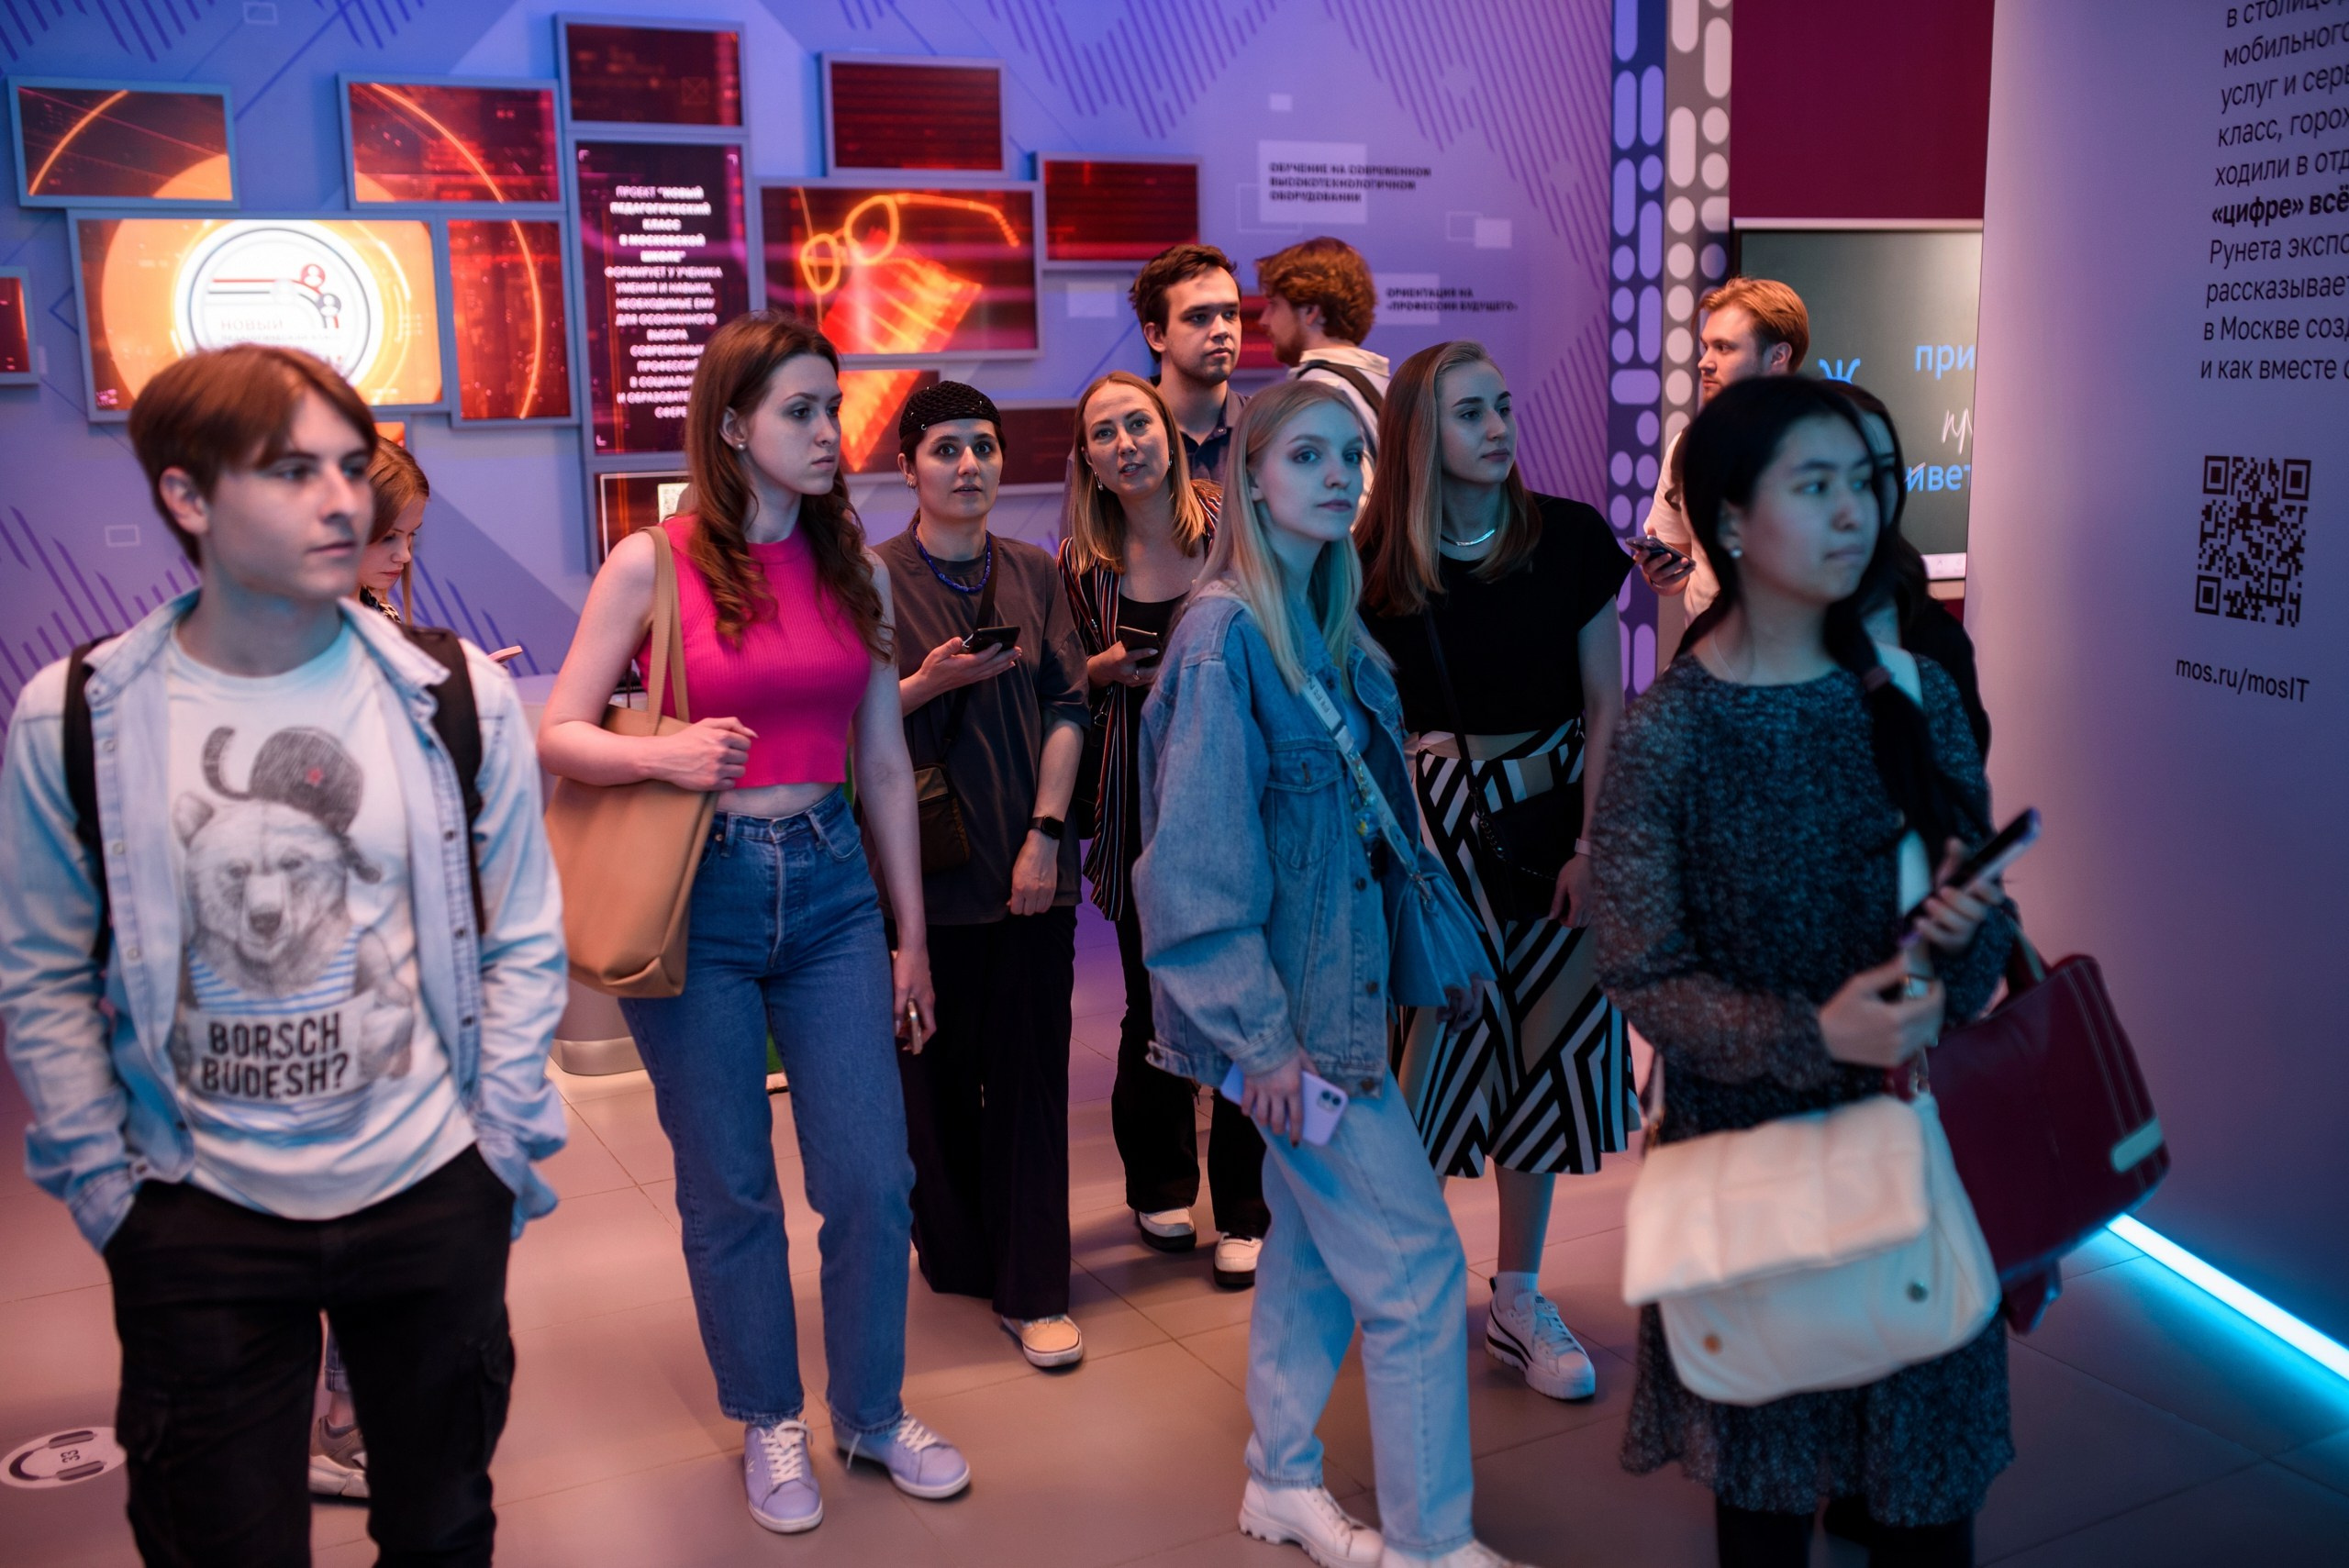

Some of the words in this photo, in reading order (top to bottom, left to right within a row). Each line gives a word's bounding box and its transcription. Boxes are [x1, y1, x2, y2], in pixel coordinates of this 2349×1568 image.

[2227, 8, 2237, 28] в
[2243, 0, 2331, 24] столи
[2224, 22, 2349, 68] мобильного
[2221, 79, 2278, 115] услуг
[2284, 75, 2296, 95] и
[2219, 119, 2282, 147] класс,
[1269, 161, 1328, 173] ОБУЧЕНИЕ
[1331, 164, 1347, 174] НА
[1349, 164, 1431, 177] СОВРЕМЕННОМ
[1270, 176, 1417, 190] ВЫСОКОТЕХНОЛОГИЧНОМ
[2215, 158, 2289, 187] ходили
[2297, 155, 2308, 175] в
[616, 185, 656, 198] ПРОЕКТ
[2212, 195, 2304, 228] «цифре»
[2210, 239, 2281, 270] Рунета
[605, 266, 666, 278] ФОРМИРУЕТ
[676, 266, 723, 278] УЧЕНИКА
[1386, 287, 1456, 298] ОРИЕНТАЦИЯ
[1459, 287, 1473, 298] НА
[2207, 275, 2349, 308] рассказывае
[2204, 322, 2214, 340] в
[2220, 316, 2299, 340] Москве
[2200, 360, 2212, 379] и
[2218, 360, 2254, 380] как
[2259, 359, 2337, 380] вместе
[2176, 659, 2310, 703] mos.ru/mosIT
[210, 1012, 340, 1060] BORSCH
[201, 1052, 349, 1099] BUDESH?
